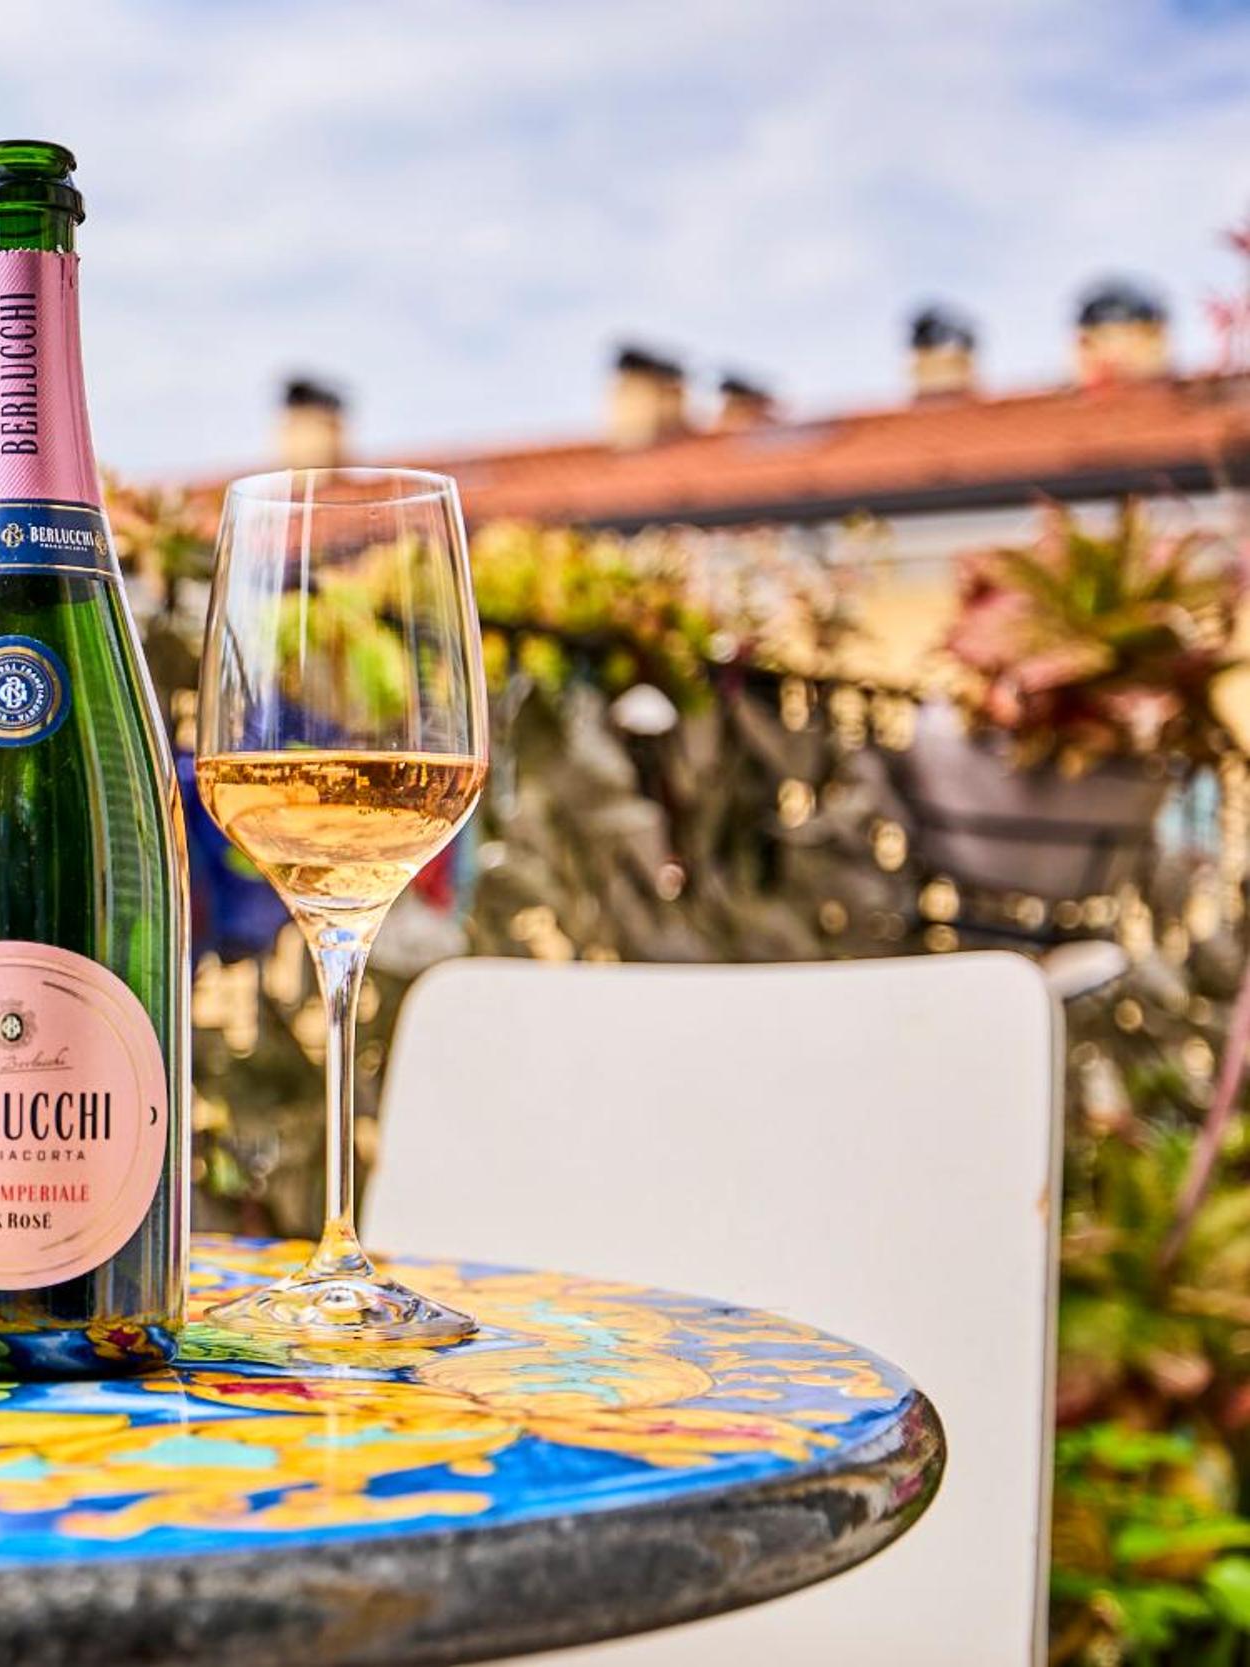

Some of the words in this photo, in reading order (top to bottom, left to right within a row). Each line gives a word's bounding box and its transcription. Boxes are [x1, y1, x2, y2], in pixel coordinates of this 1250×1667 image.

[0, 293, 39, 454] BERLUCCHI
[30, 526, 94, 546] BERLUCCHI
[8, 1211, 52, 1229] ROSÉ
